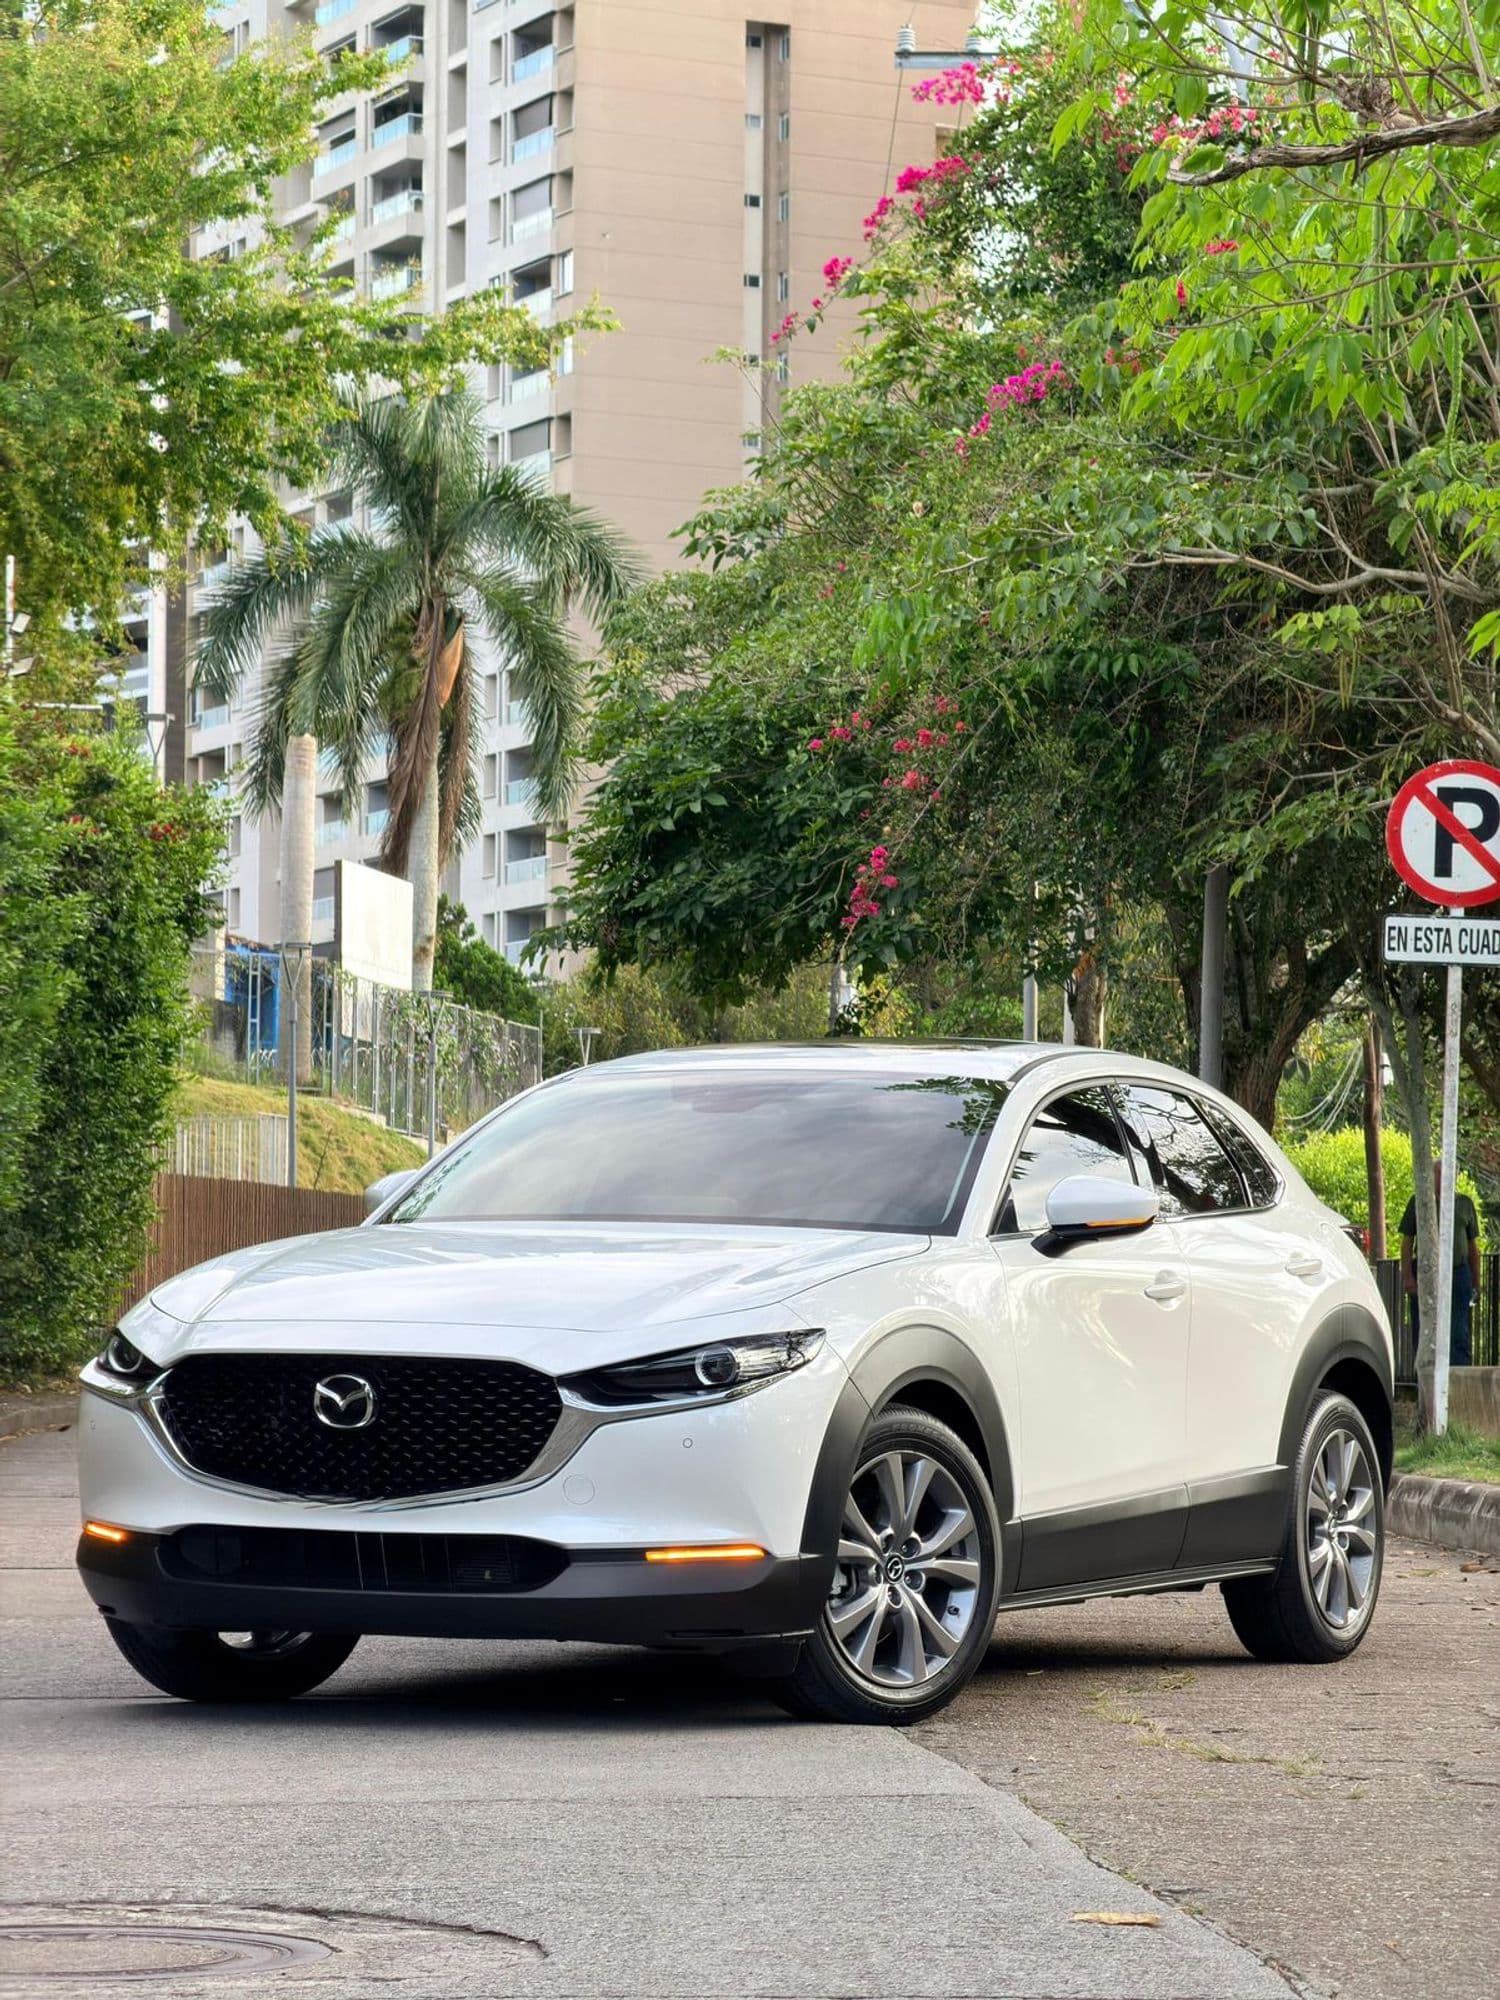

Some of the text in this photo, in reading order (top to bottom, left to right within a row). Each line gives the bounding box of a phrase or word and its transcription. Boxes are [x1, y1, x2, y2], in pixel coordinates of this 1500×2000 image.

[1434, 787, 1500, 878] P
[1387, 926, 1500, 955] EN ESTA CUAD
